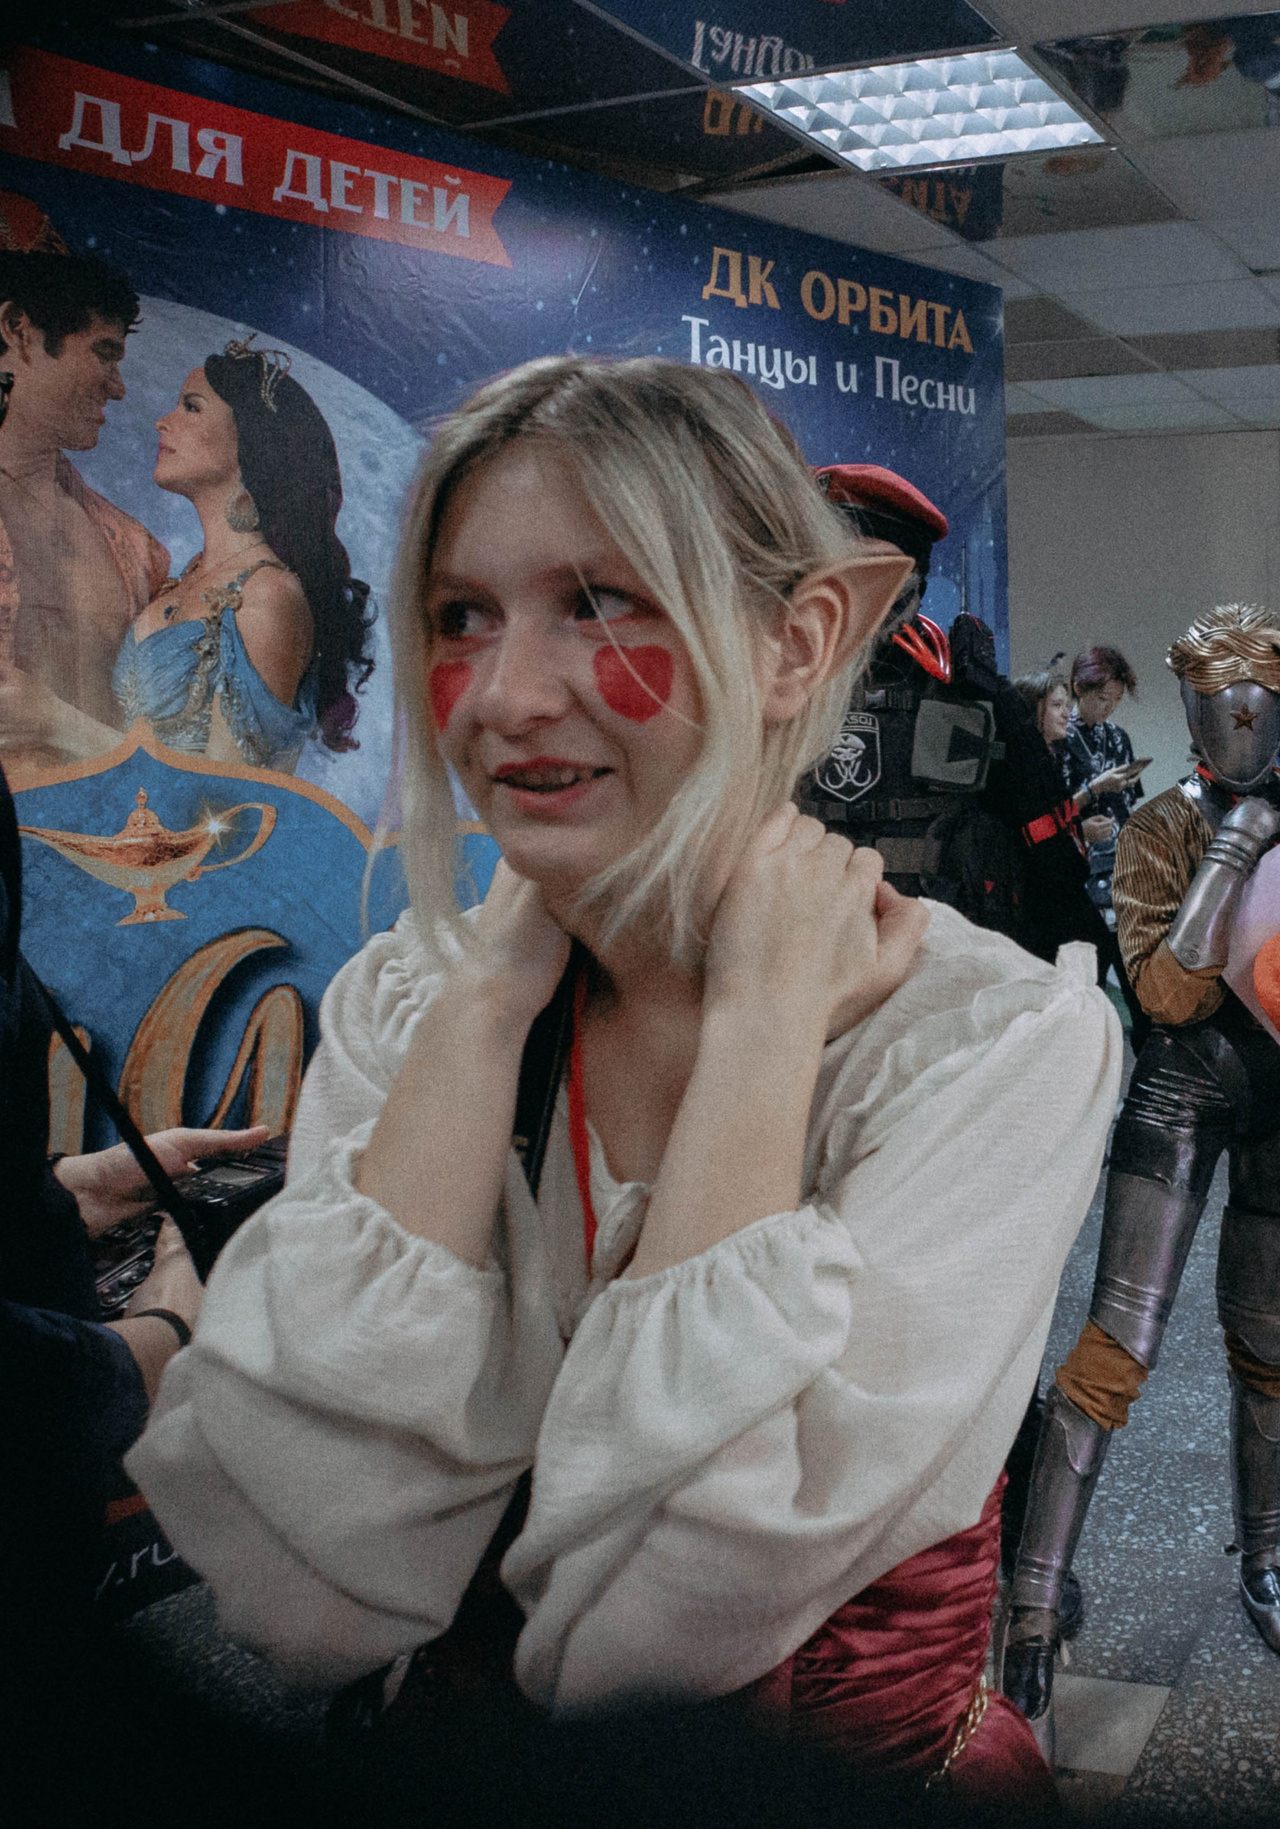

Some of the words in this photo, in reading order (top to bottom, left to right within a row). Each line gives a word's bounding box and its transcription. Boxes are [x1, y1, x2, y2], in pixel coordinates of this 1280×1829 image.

[58, 90, 244, 186] ДЛЯ
[272, 148, 471, 238] ДЕТЕЙ
[702, 246, 780, 311] ДК
[801, 270, 974, 355] ОРБИТА
[681, 314, 817, 390] Танцы
[836, 360, 858, 394] и
[875, 355, 976, 415] Песни
